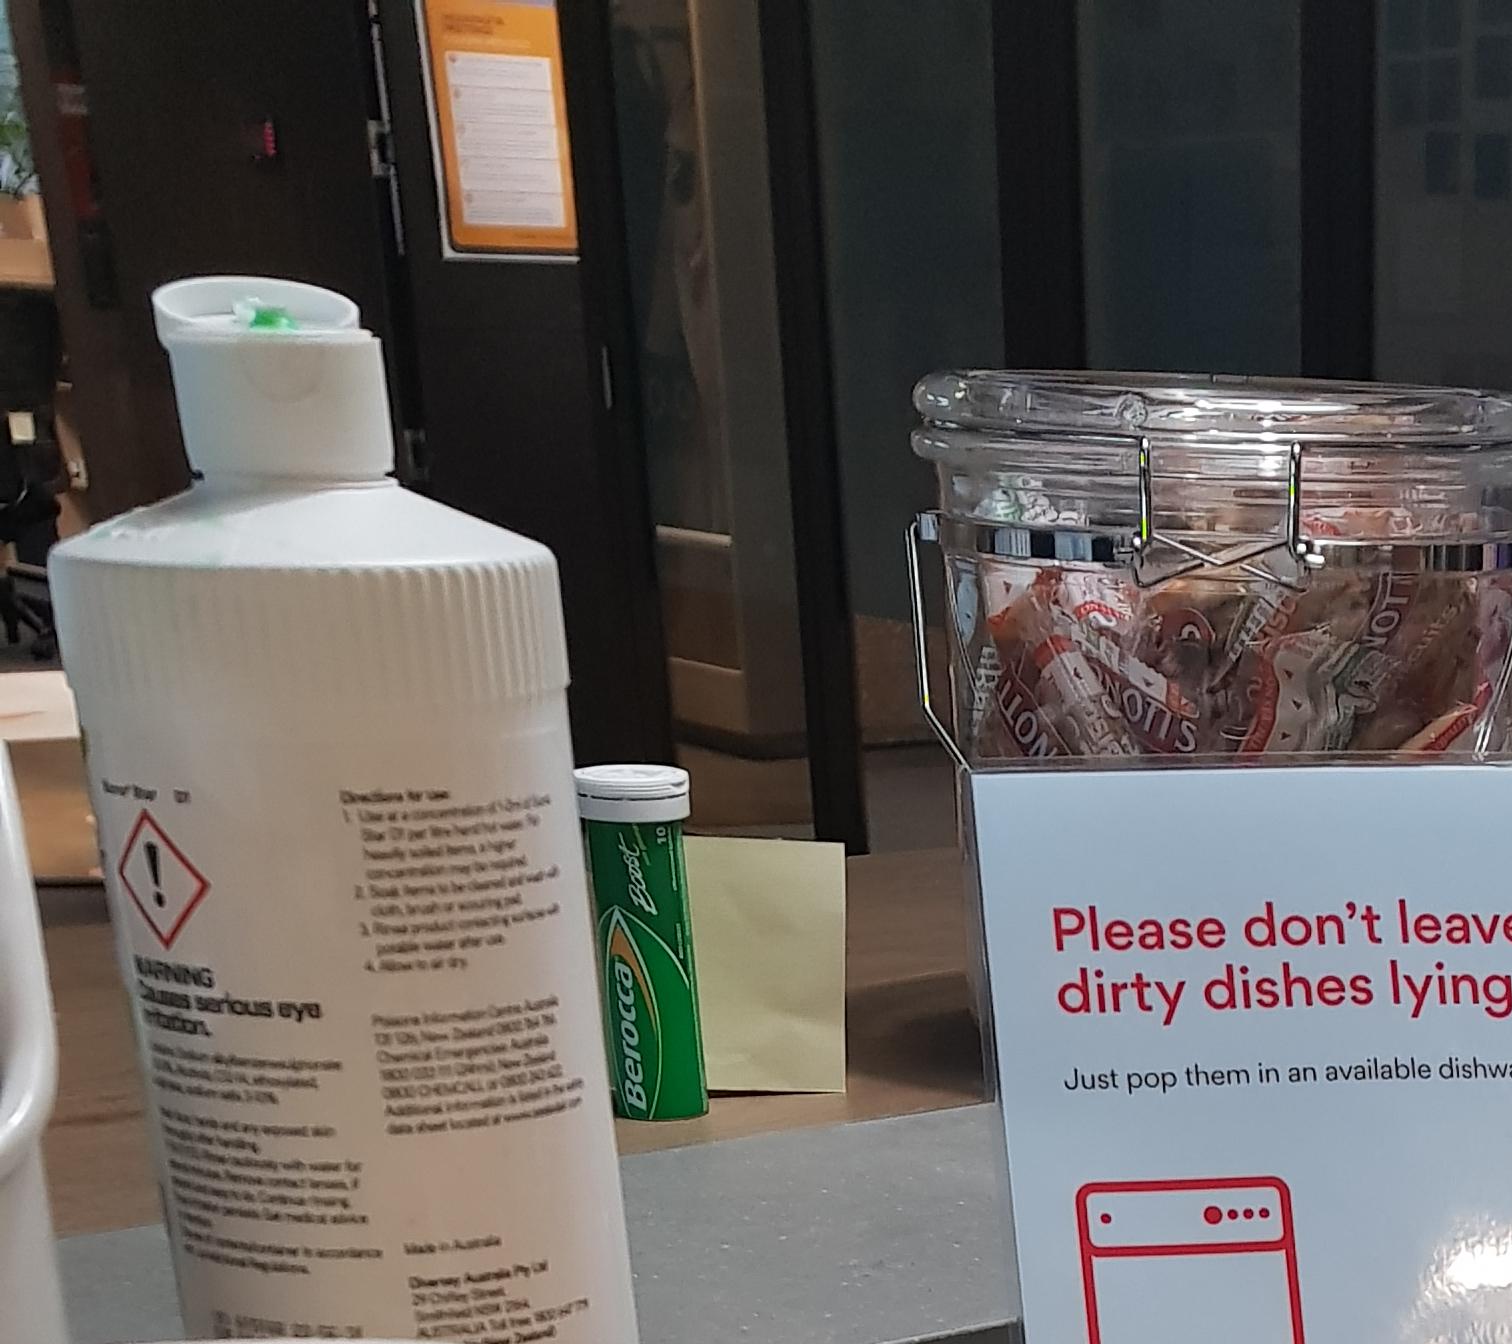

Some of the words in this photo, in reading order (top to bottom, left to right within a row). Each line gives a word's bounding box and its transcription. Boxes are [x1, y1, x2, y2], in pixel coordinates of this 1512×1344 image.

[657, 826, 667, 845] 10
[1053, 907, 1224, 952] Please
[1244, 902, 1380, 948] don’t
[1057, 968, 1185, 1025] dirty
[1203, 963, 1372, 1011] dishes
[1390, 960, 1512, 1019] lying
[614, 960, 648, 1112] Berocca
[1064, 1068, 1119, 1091] Just
[1126, 1071, 1178, 1095] pop
[1185, 1063, 1250, 1087] them
[1258, 1062, 1280, 1084] in
[1288, 1066, 1318, 1083] an
[1325, 1057, 1432, 1082] available
